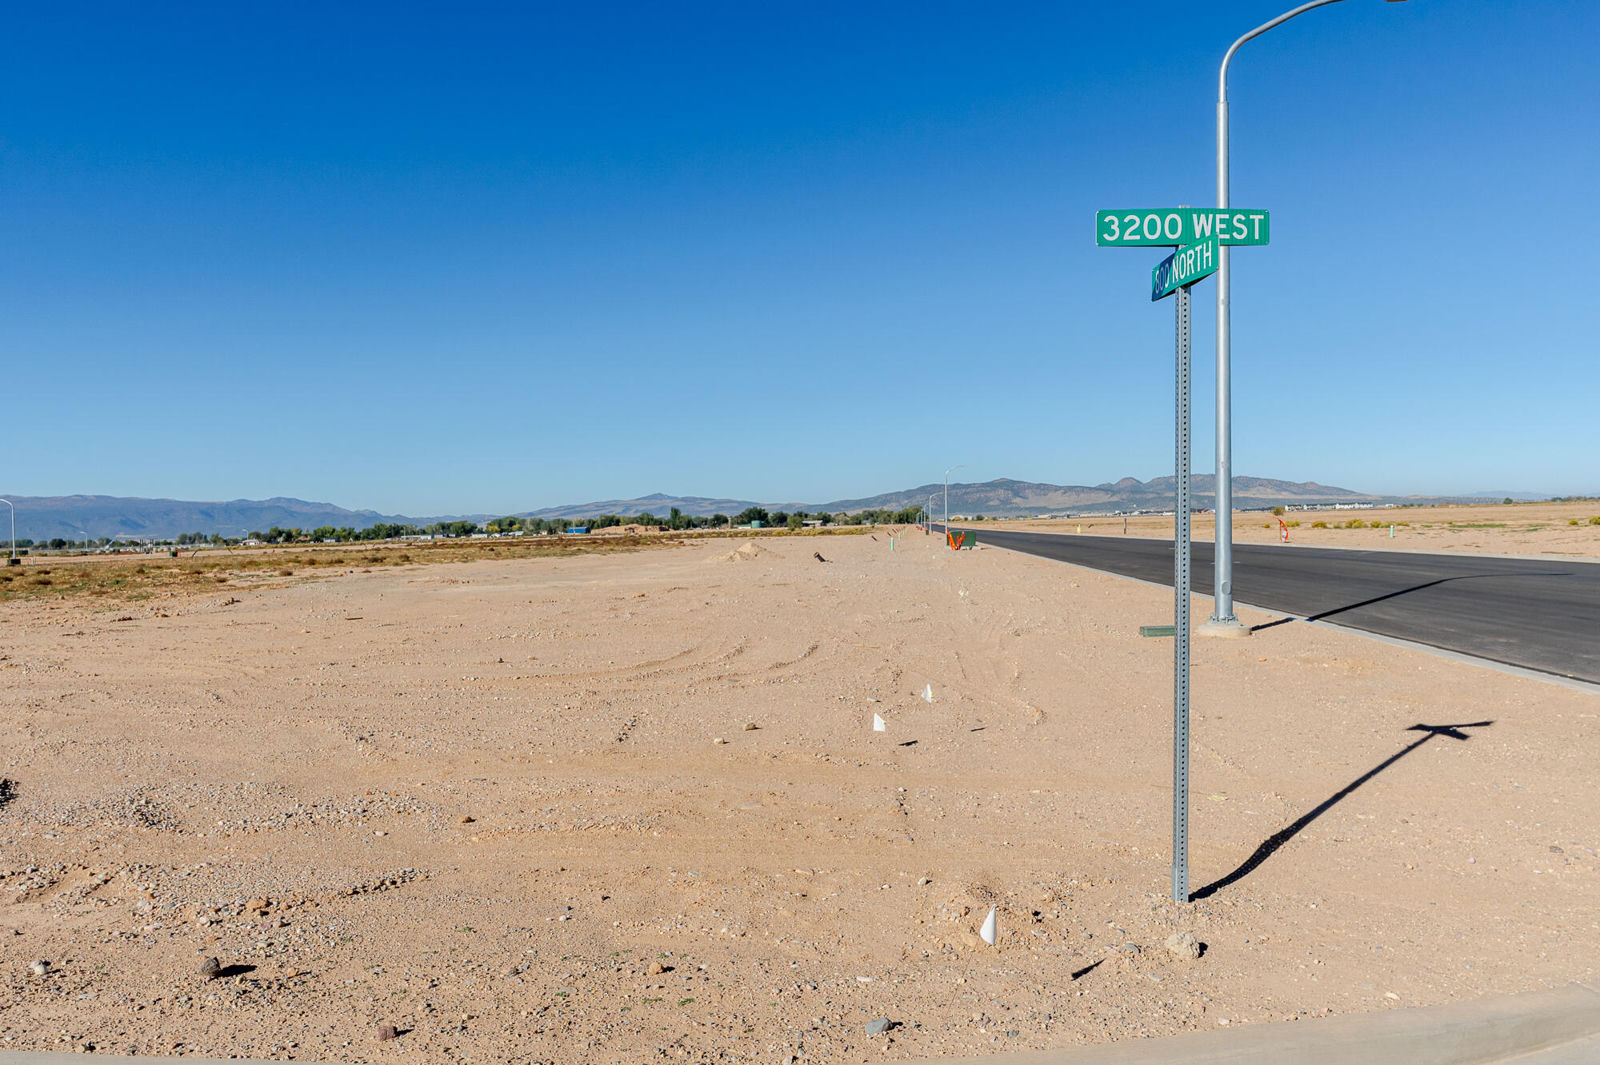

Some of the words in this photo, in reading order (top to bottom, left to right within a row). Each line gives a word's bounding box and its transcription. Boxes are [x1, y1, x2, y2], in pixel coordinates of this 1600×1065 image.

[1103, 214, 1182, 241] 3200
[1192, 214, 1264, 240] WEST
[1172, 240, 1212, 284] NORTH
